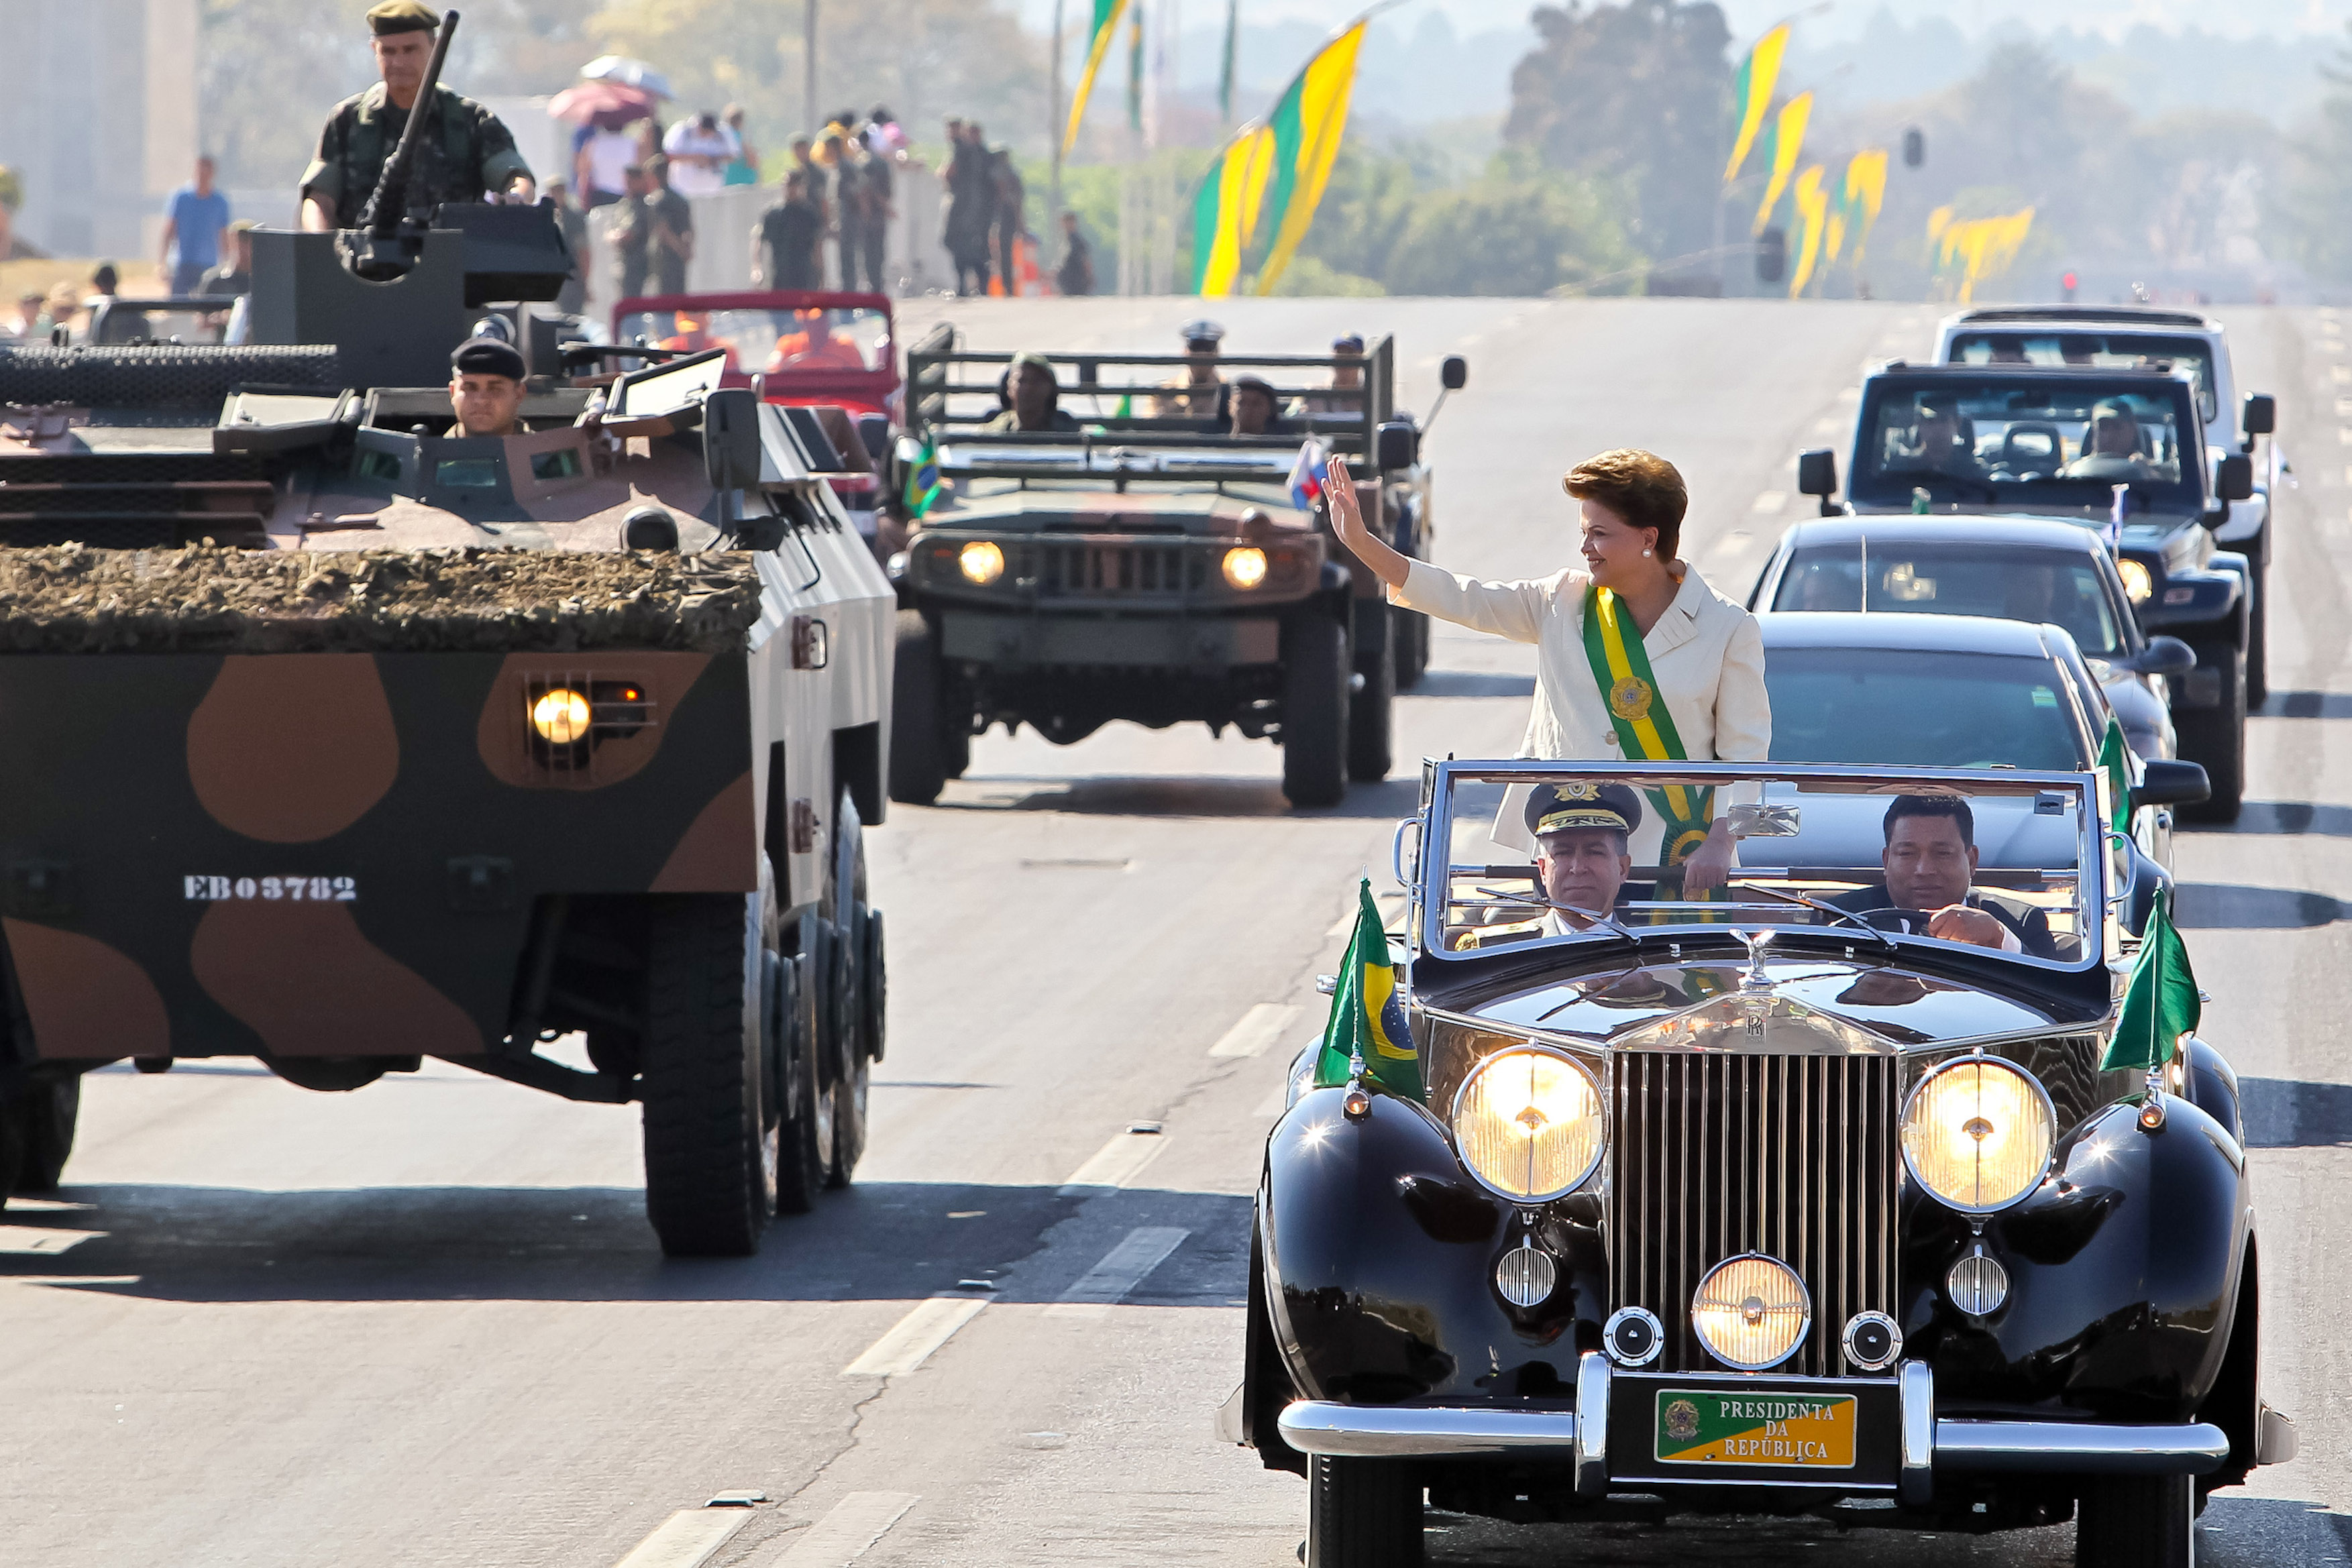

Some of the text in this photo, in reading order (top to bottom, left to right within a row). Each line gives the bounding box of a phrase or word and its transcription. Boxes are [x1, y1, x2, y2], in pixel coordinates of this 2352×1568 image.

[1720, 1401, 1834, 1420] PRESIDENTA
[1765, 1420, 1788, 1437] DA
[1724, 1437, 1828, 1458] REPÚBLICA
